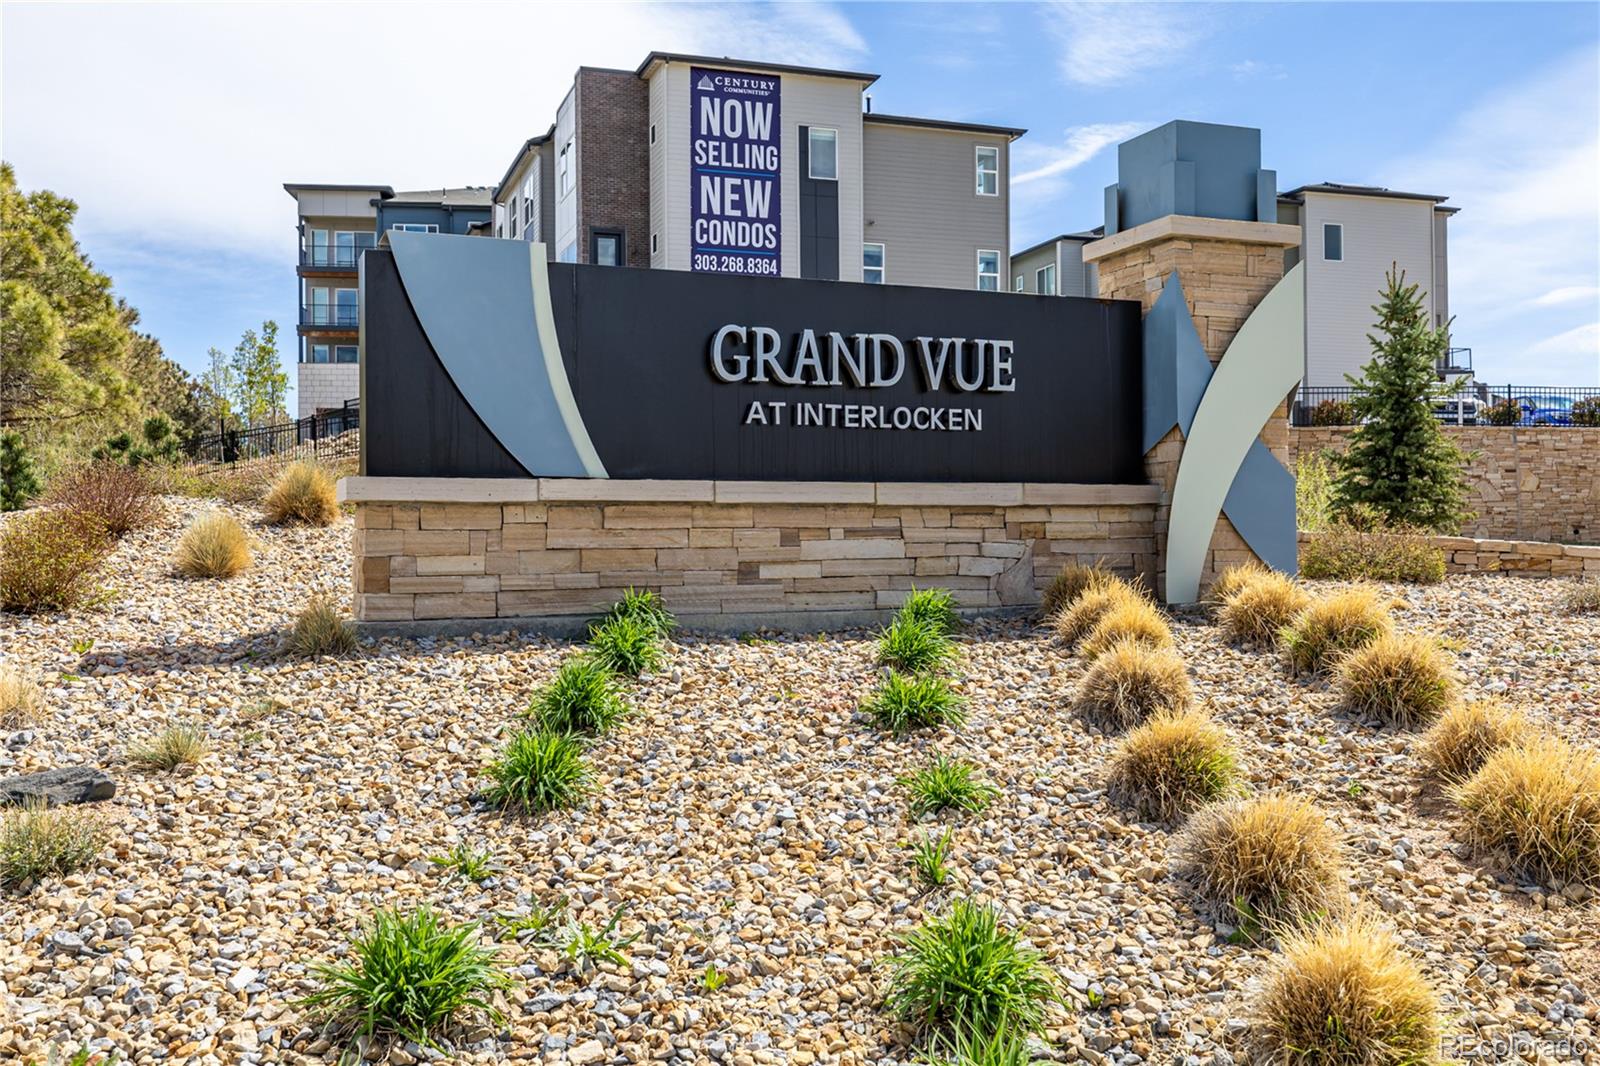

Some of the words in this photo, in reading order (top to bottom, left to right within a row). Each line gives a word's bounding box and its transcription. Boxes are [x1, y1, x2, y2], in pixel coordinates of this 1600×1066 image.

[714, 76, 775, 90] CENTURY
[701, 96, 773, 141] NOW
[695, 139, 778, 171] SELLING
[701, 175, 772, 219] NEW
[695, 218, 777, 249] CONDOS
[694, 254, 777, 275] 303.268.8364
[711, 324, 906, 388] GRAND
[914, 336, 1016, 392] VUE
[745, 401, 786, 426] AT
[797, 402, 983, 431] INTERLOCKEN
